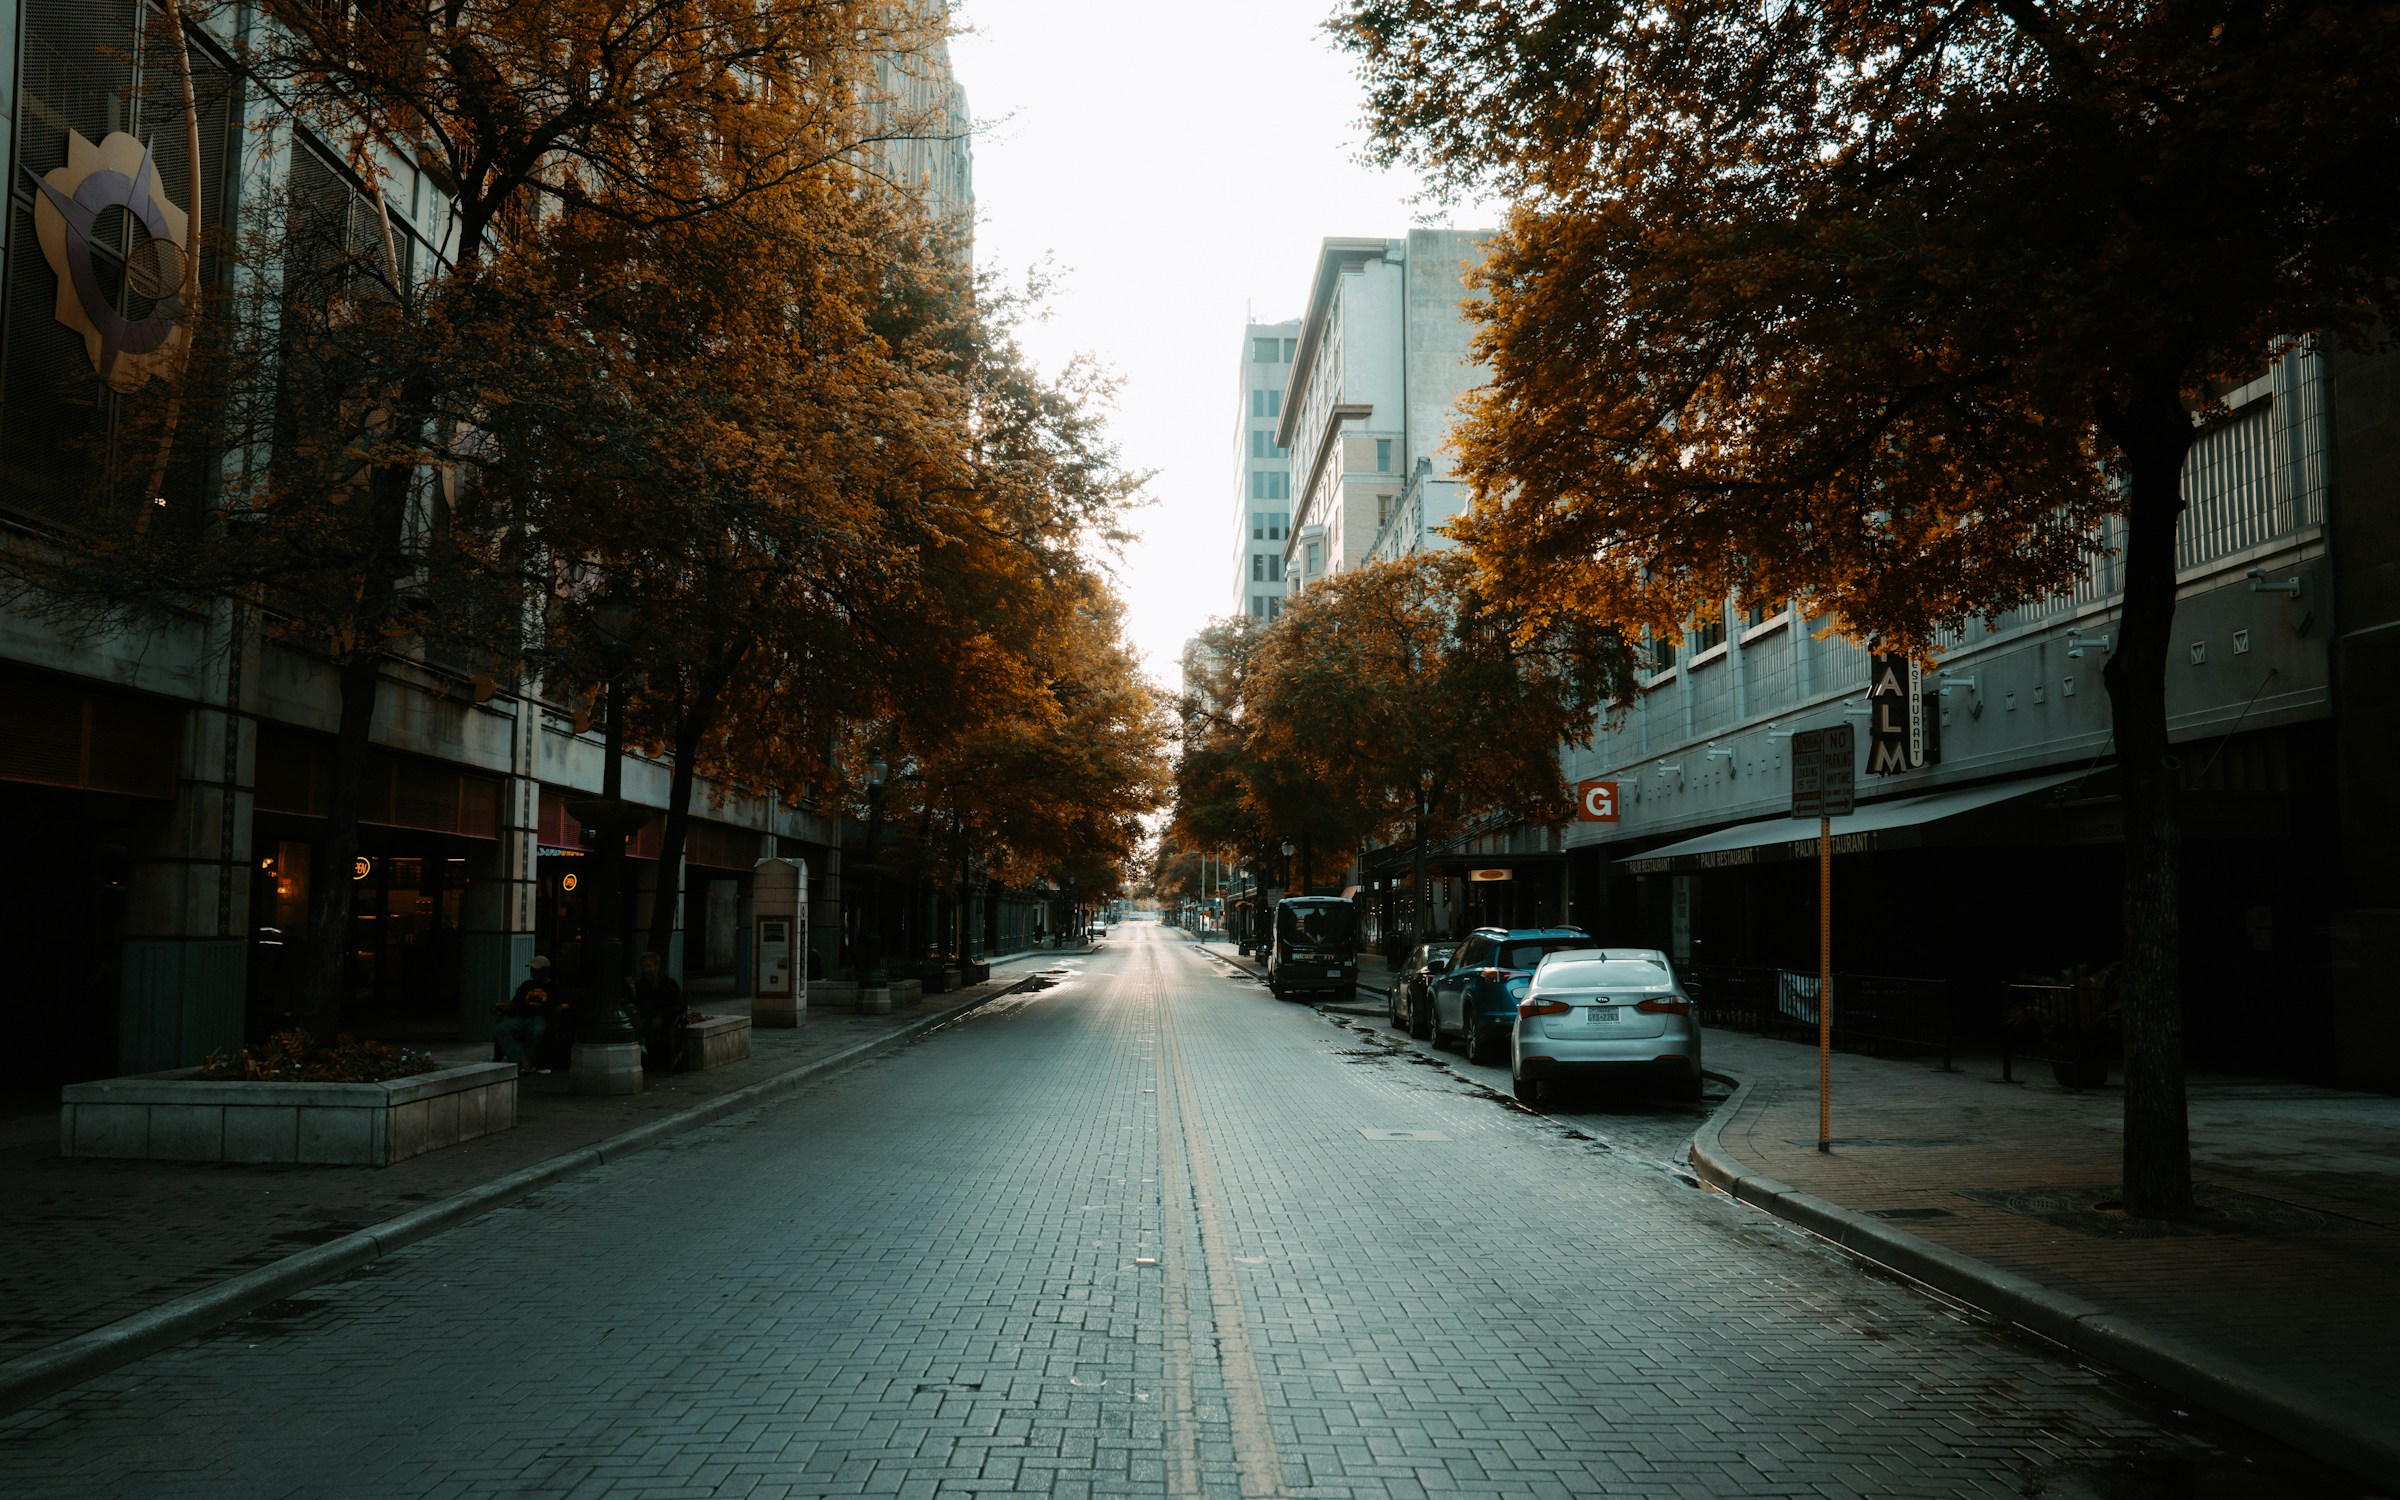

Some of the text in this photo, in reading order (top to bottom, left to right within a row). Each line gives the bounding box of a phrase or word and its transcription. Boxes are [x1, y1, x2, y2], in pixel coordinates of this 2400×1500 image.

[1830, 732, 1846, 749] NO
[1825, 752, 1851, 769] PARKING
[1797, 781, 1804, 790] 15
[1827, 771, 1851, 785] ANYTIME
[1586, 787, 1613, 816] G
[1793, 832, 1867, 858] PALM RTAURANT
[1629, 857, 1671, 874] PALM RESTAURANT
[1700, 847, 1754, 869] PALM RESTAURANT
